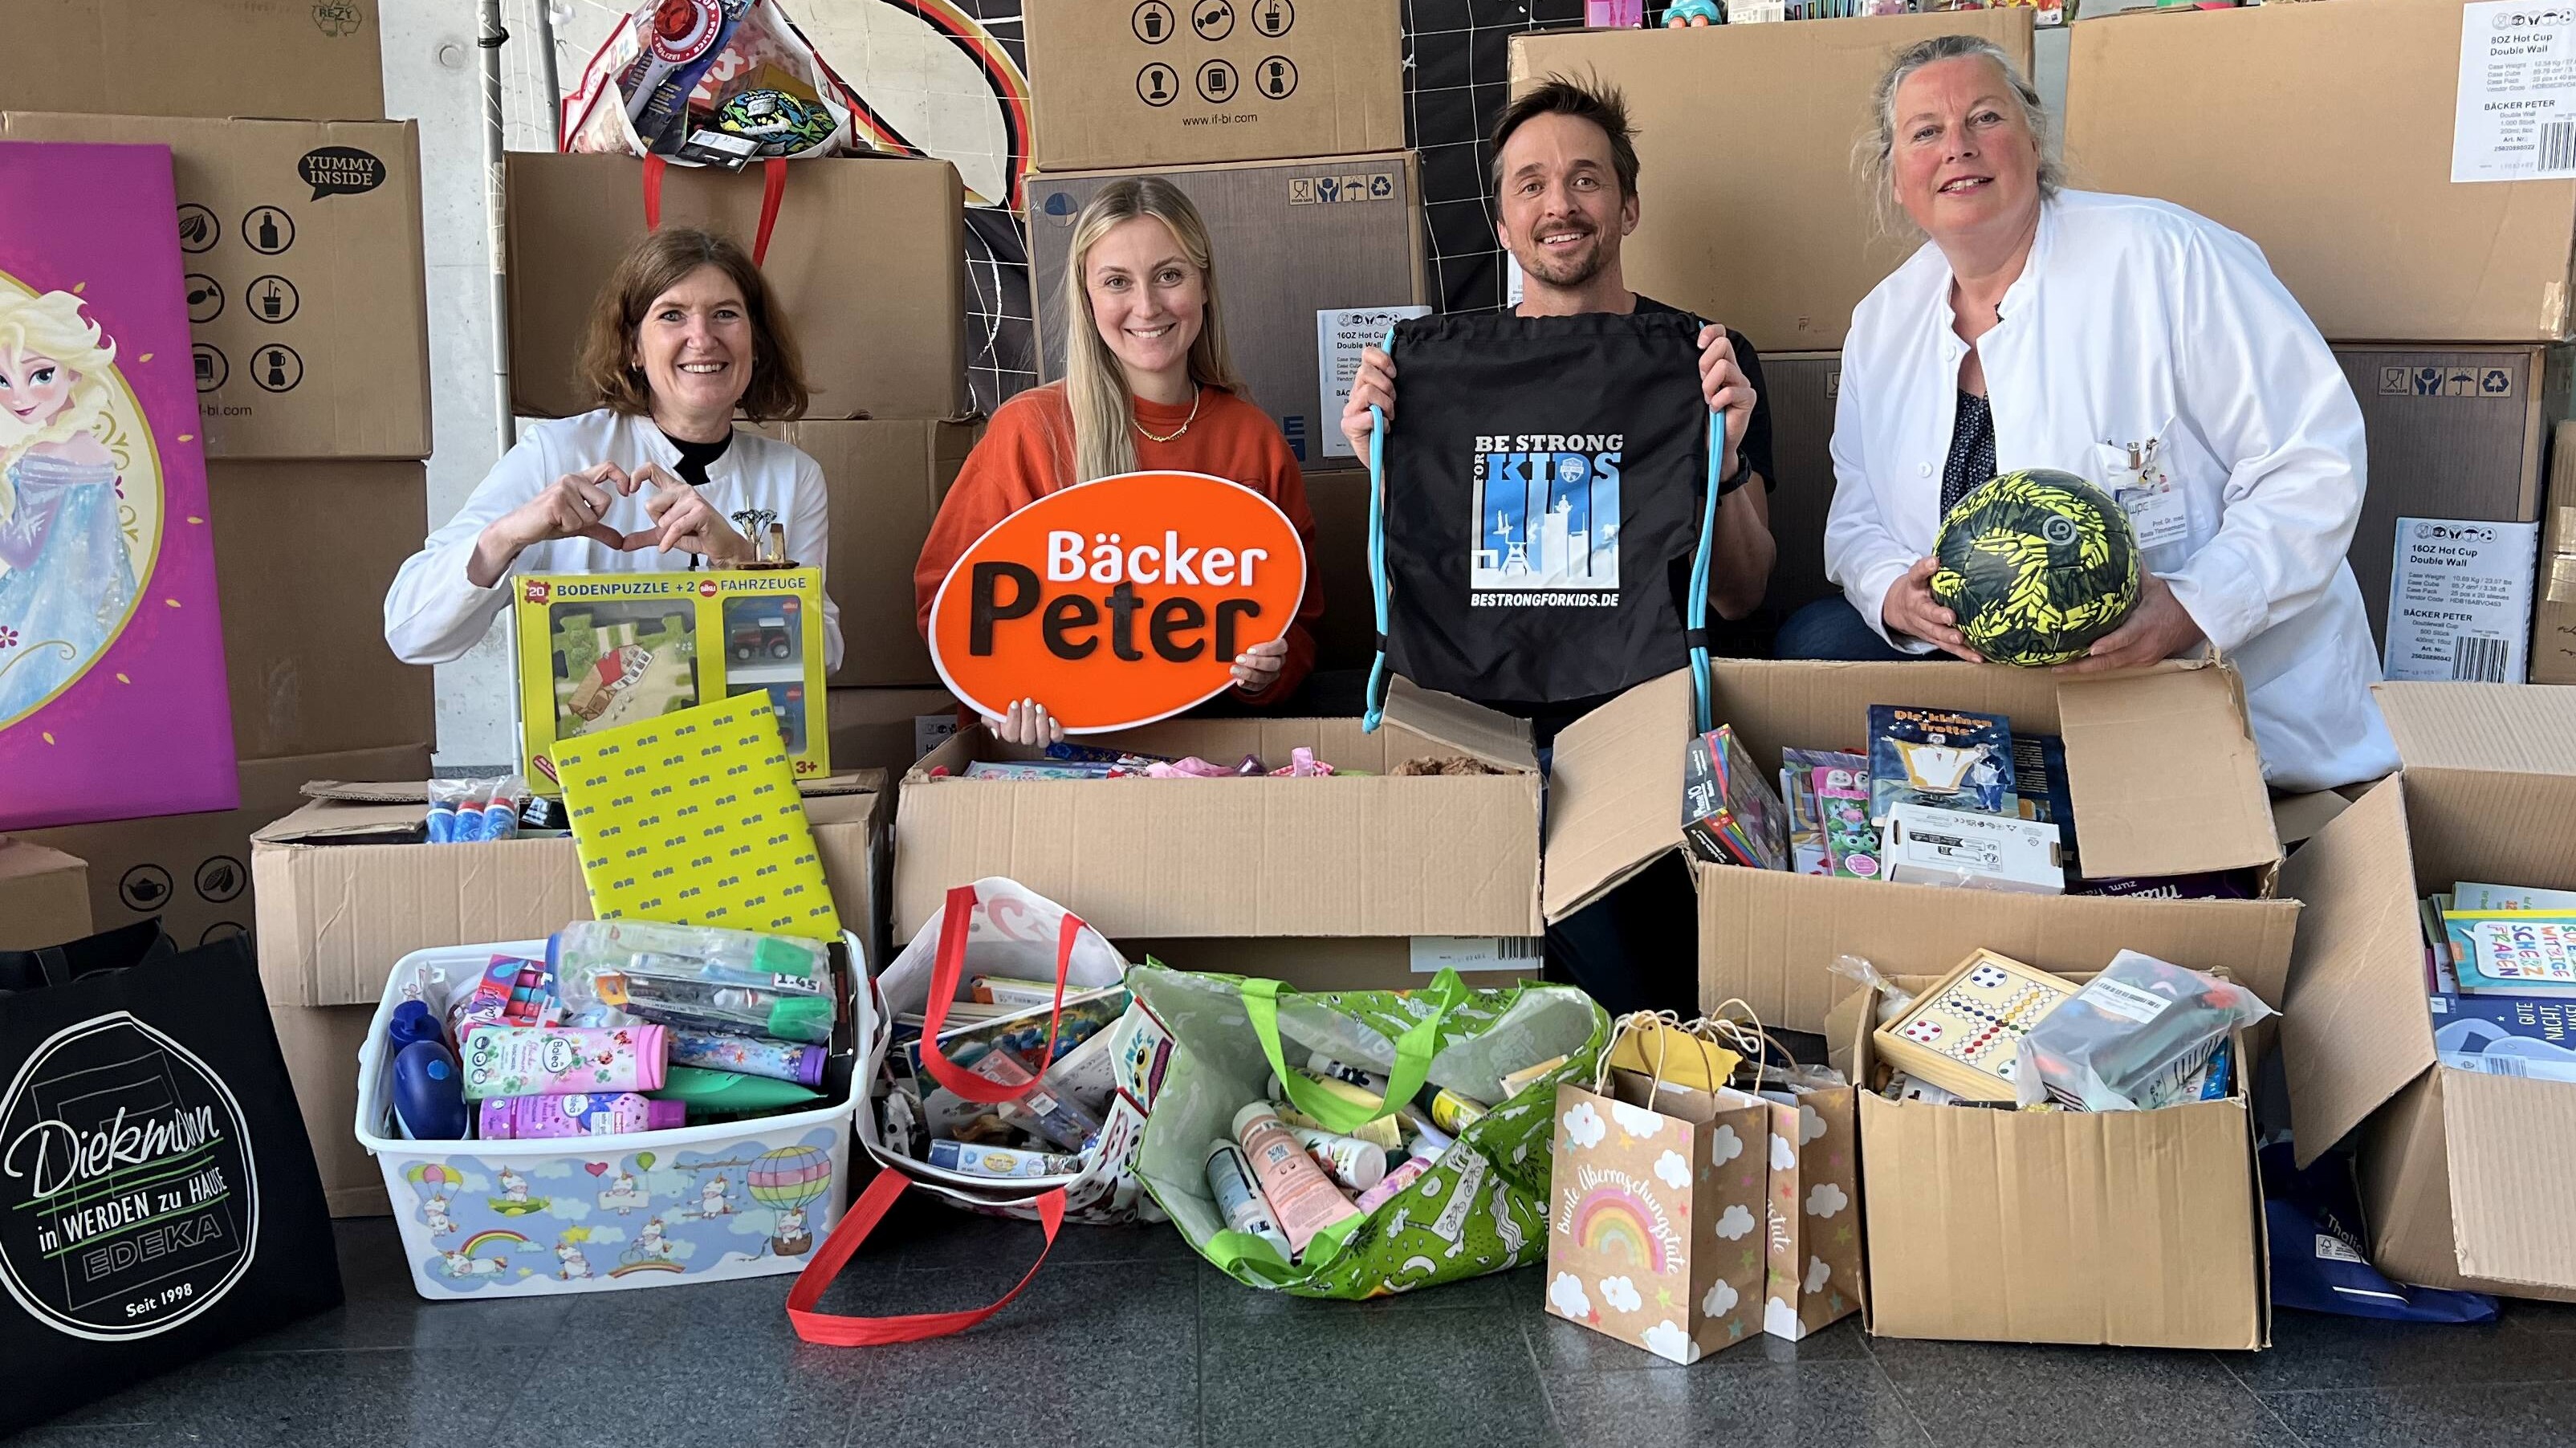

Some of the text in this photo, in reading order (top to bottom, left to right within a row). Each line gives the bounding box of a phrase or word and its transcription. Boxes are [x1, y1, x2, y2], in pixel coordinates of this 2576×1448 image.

[319, 6, 352, 21] REZY
[693, 22, 715, 53] POLICE
[2513, 35, 2530, 43] Hot
[2533, 33, 2553, 43] Cup
[655, 43, 681, 61] POLIZEI
[2490, 45, 2547, 56] Double Wall
[2484, 100, 2555, 111] BÄCKER PETER
[1182, 113, 1258, 125] www.if-bi.com
[307, 156, 376, 172] YUMMY
[310, 170, 373, 186] INSIDE
[1337, 331, 1357, 340] 16OZ
[1358, 331, 1372, 340] Hot
[1337, 341, 1363, 349] Double
[1475, 434, 1623, 452] BE STRONG
[1474, 454, 1485, 481] FOR
[1486, 452, 1622, 481] KIDS
[1048, 531, 1268, 586] Bäcker
[2412, 544, 2478, 558] 16OZ Hot Cup
[2410, 555, 2467, 567] Double Wall
[529, 586, 545, 597] 20
[557, 582, 669, 596] BODENPUZZLE
[676, 584, 685, 592] +
[686, 582, 695, 592] 2
[721, 577, 807, 591] FAHRZEUGE
[1471, 592, 1619, 608] BESTRONGFORKIDS.DE
[970, 562, 1261, 663] Peter
[2403, 608, 2472, 622] BÄCKER PETER
[1894, 710, 1922, 721] Die
[796, 760, 818, 775] 3+
[2487, 925, 2520, 977] FRAGEN
[2511, 925, 2544, 976] SCHERZ
[777, 973, 818, 990] 1.45
[2516, 1002, 2536, 1025] GUTE
[2539, 1004, 2565, 1040] NACHT,
[551, 1041, 563, 1068] Balea
[4, 1105, 219, 1198] Diekmann
[38, 1166, 227, 1252] in WERDEN zu HAUSE
[1557, 1187, 1580, 1235] Bunte
[2328, 1214, 2363, 1255] Thalia
[83, 1214, 222, 1282] EDEKA
[126, 1283, 193, 1317] Seit 1998
